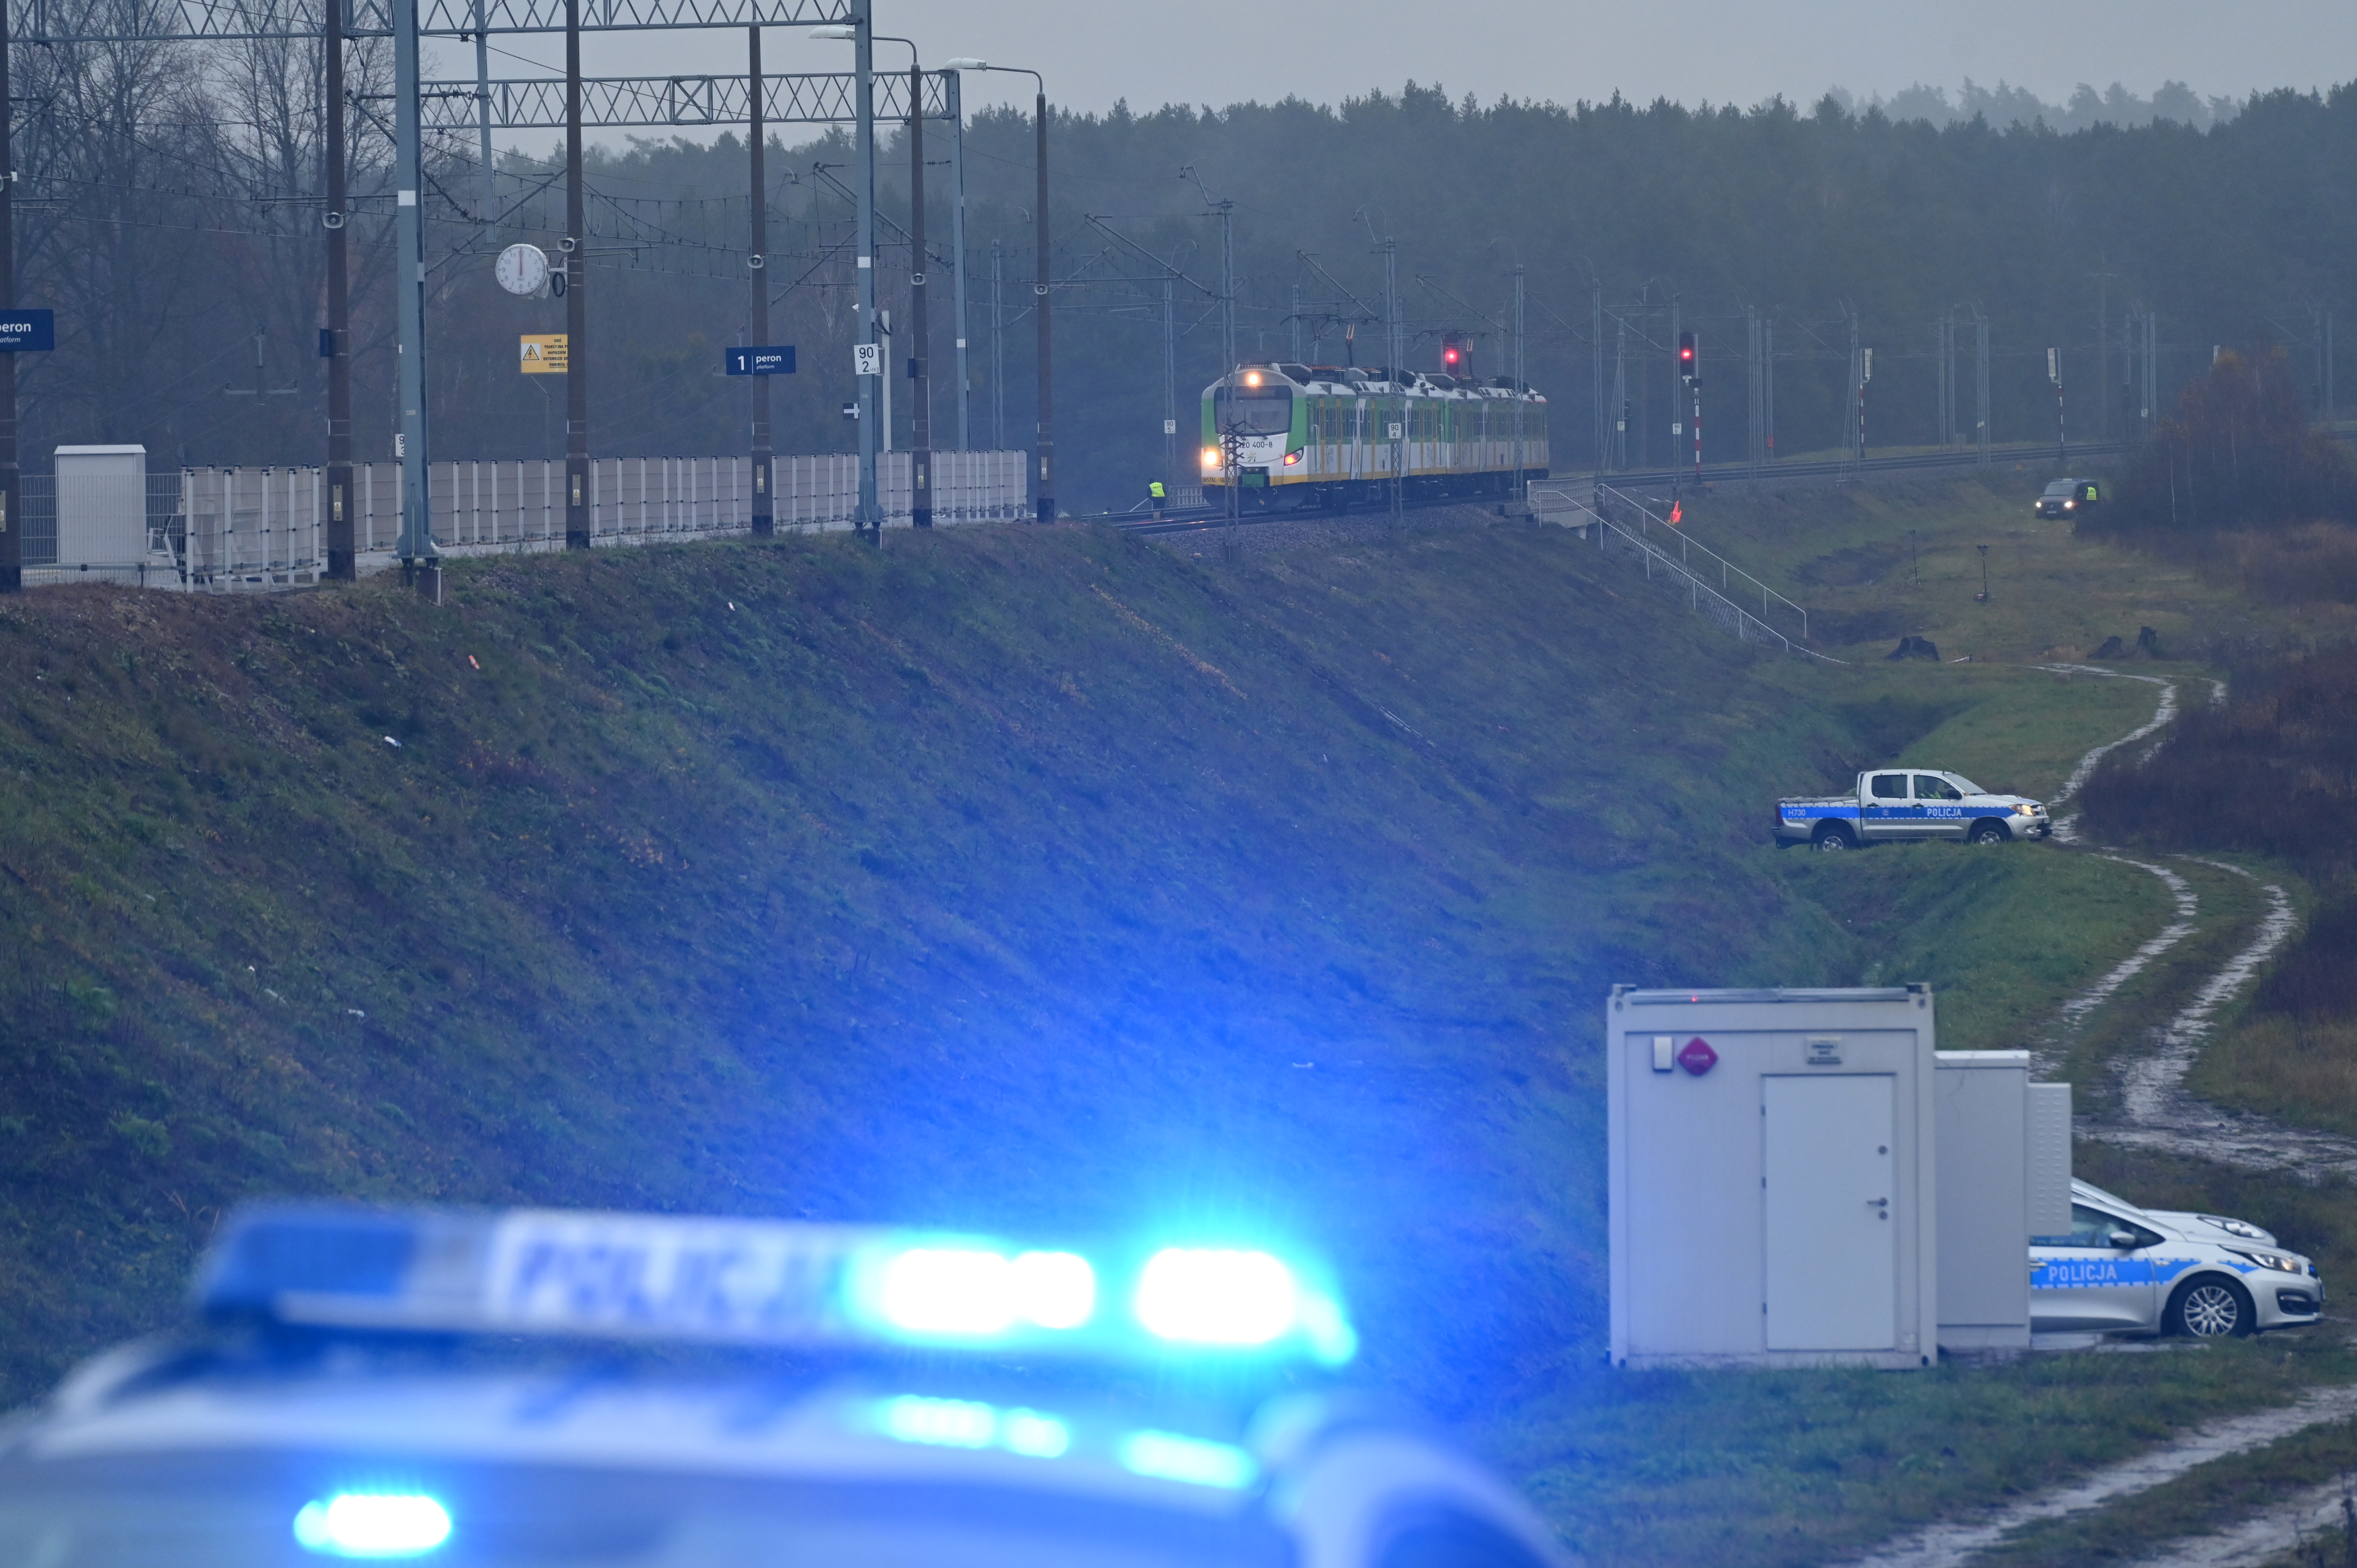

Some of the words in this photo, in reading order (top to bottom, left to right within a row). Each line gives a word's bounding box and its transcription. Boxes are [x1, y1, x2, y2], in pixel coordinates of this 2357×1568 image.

[0, 323, 31, 332] eron
[859, 346, 874, 358] 90
[738, 355, 744, 371] 1
[756, 355, 781, 364] peron
[862, 361, 869, 373] 2
[1927, 808, 1962, 817] POLICJA
[2049, 1264, 2117, 1282] POLICJA
